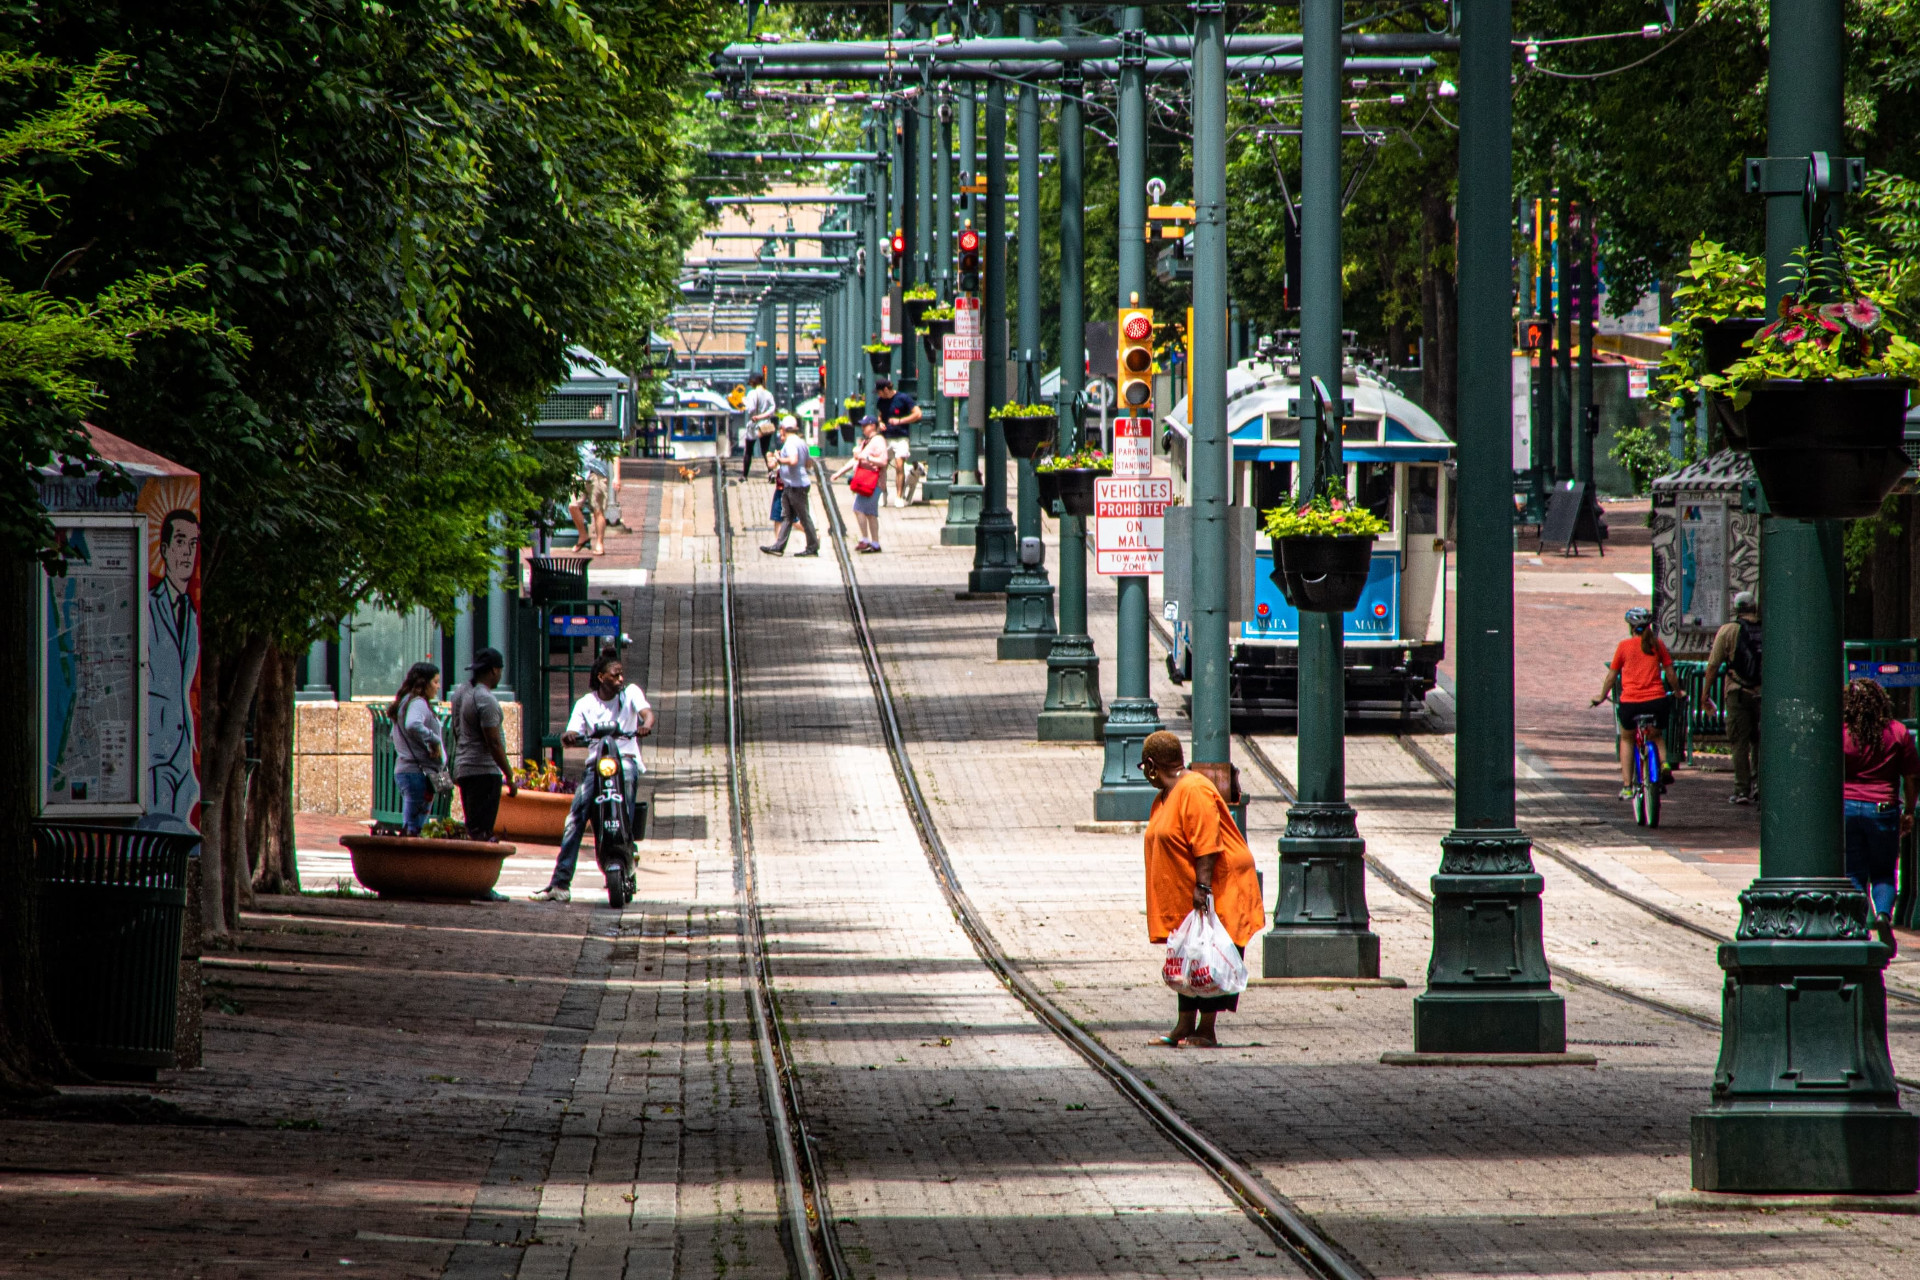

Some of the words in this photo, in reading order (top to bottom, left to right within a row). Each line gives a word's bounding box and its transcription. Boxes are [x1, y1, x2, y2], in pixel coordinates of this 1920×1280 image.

[947, 338, 982, 348] VEHICLE
[1124, 428, 1142, 436] LANE
[1128, 438, 1138, 447] NO
[1118, 447, 1148, 457] PARKING
[1116, 461, 1150, 470] STANDING
[1101, 483, 1168, 498] VEHICLES
[1126, 520, 1143, 533] ON
[1118, 535, 1151, 547] MALL
[1111, 553, 1159, 562] TOW-AWAY
[1122, 563, 1147, 572] ZONE
[1258, 618, 1287, 629] MATA
[1354, 619, 1384, 630] MATA
